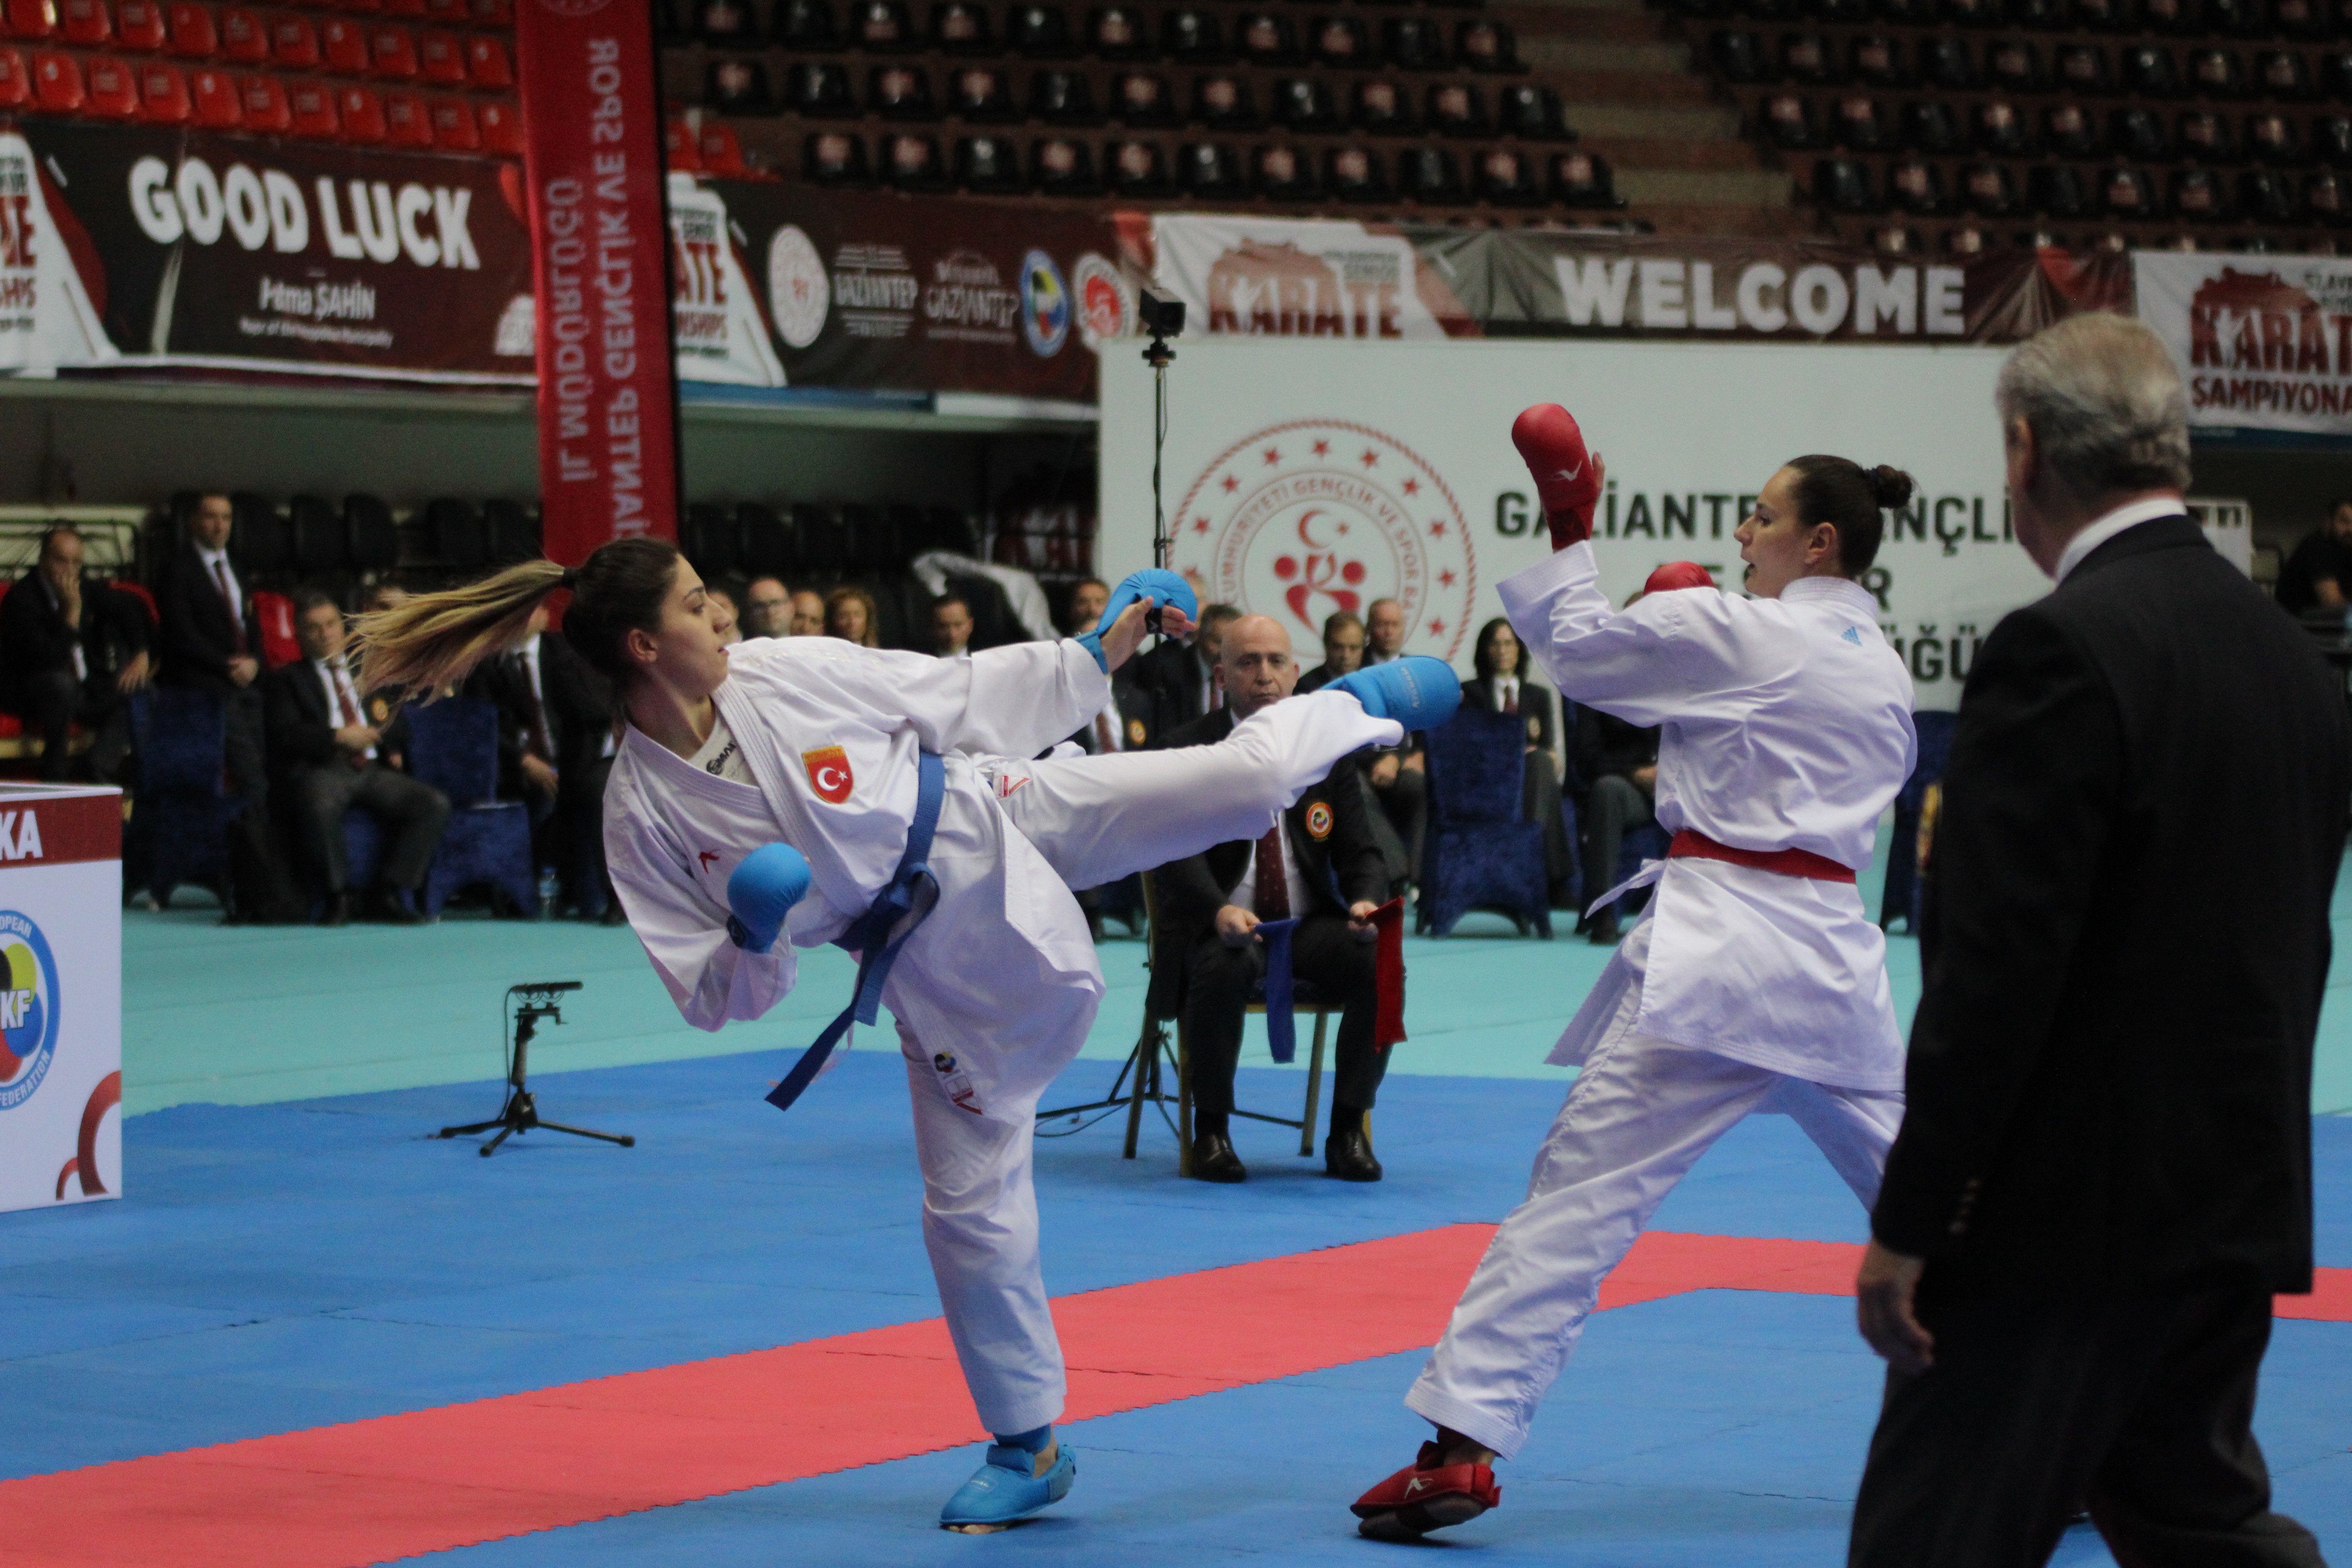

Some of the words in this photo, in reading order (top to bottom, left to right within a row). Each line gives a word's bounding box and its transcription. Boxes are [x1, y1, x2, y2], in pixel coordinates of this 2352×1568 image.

[129, 156, 309, 253] GOOD
[316, 175, 481, 270] LUCK
[1553, 257, 1965, 335] WELCOME
[2191, 304, 2352, 377] KARAT
[0, 809, 44, 861] KA
[0, 916, 32, 938] OPEAN
[0, 989, 31, 1029] KF
